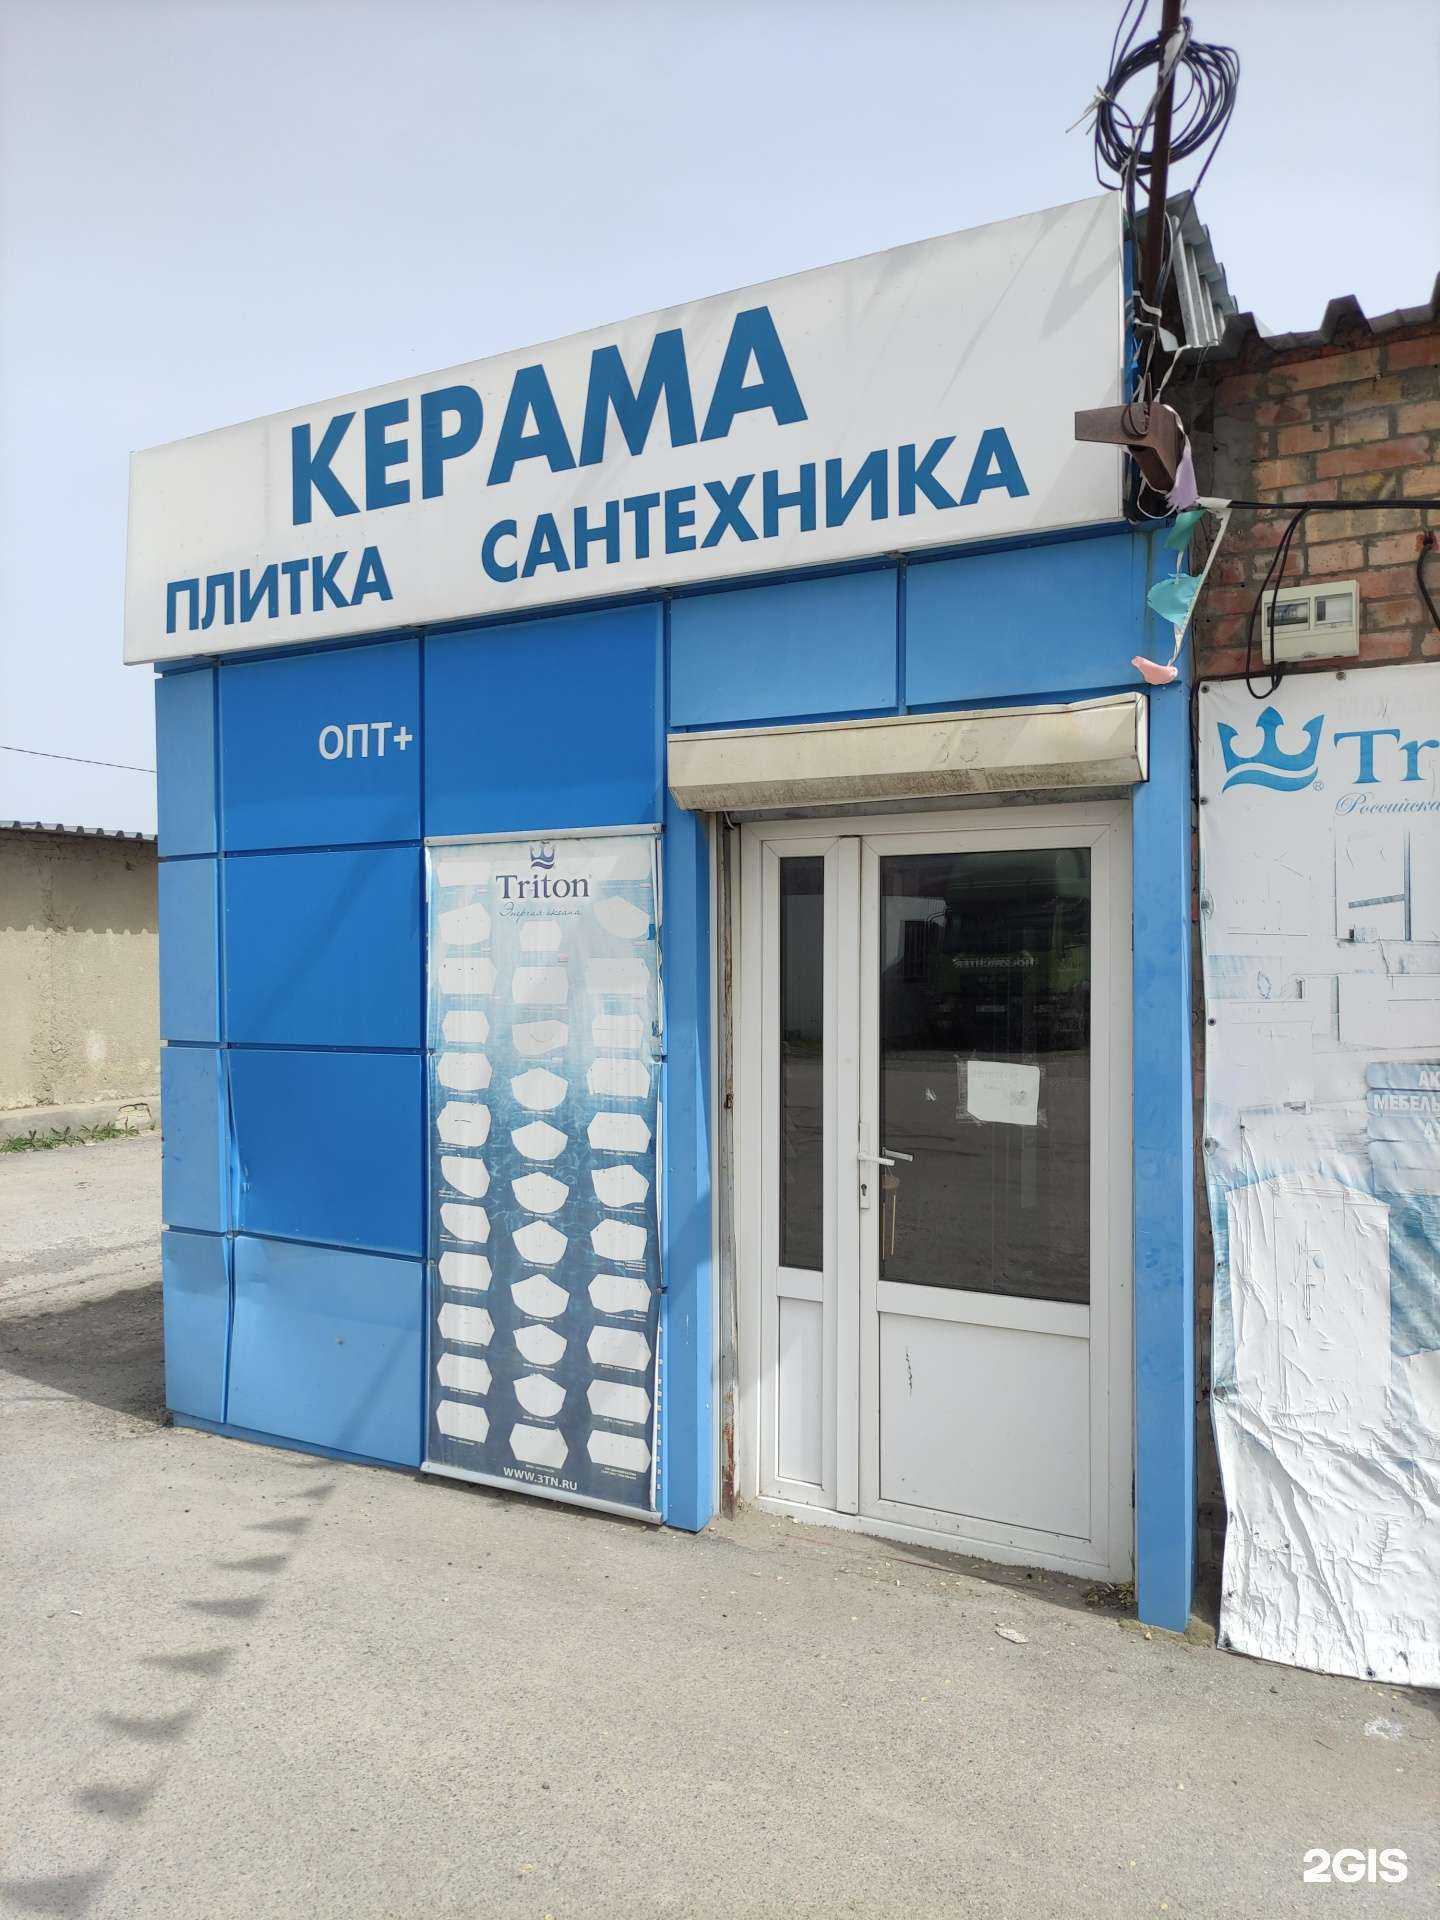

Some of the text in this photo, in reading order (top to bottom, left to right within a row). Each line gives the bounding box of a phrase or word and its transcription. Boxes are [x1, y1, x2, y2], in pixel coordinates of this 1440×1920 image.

[291, 305, 808, 526] КЕРАМА
[481, 427, 1030, 584] САНТЕХНИКА
[165, 546, 393, 635] ПЛИТКА
[318, 721, 413, 761] ОПТ+
[495, 874, 590, 899] Triton
[502, 1467, 578, 1491] WWW.3TN.RU
